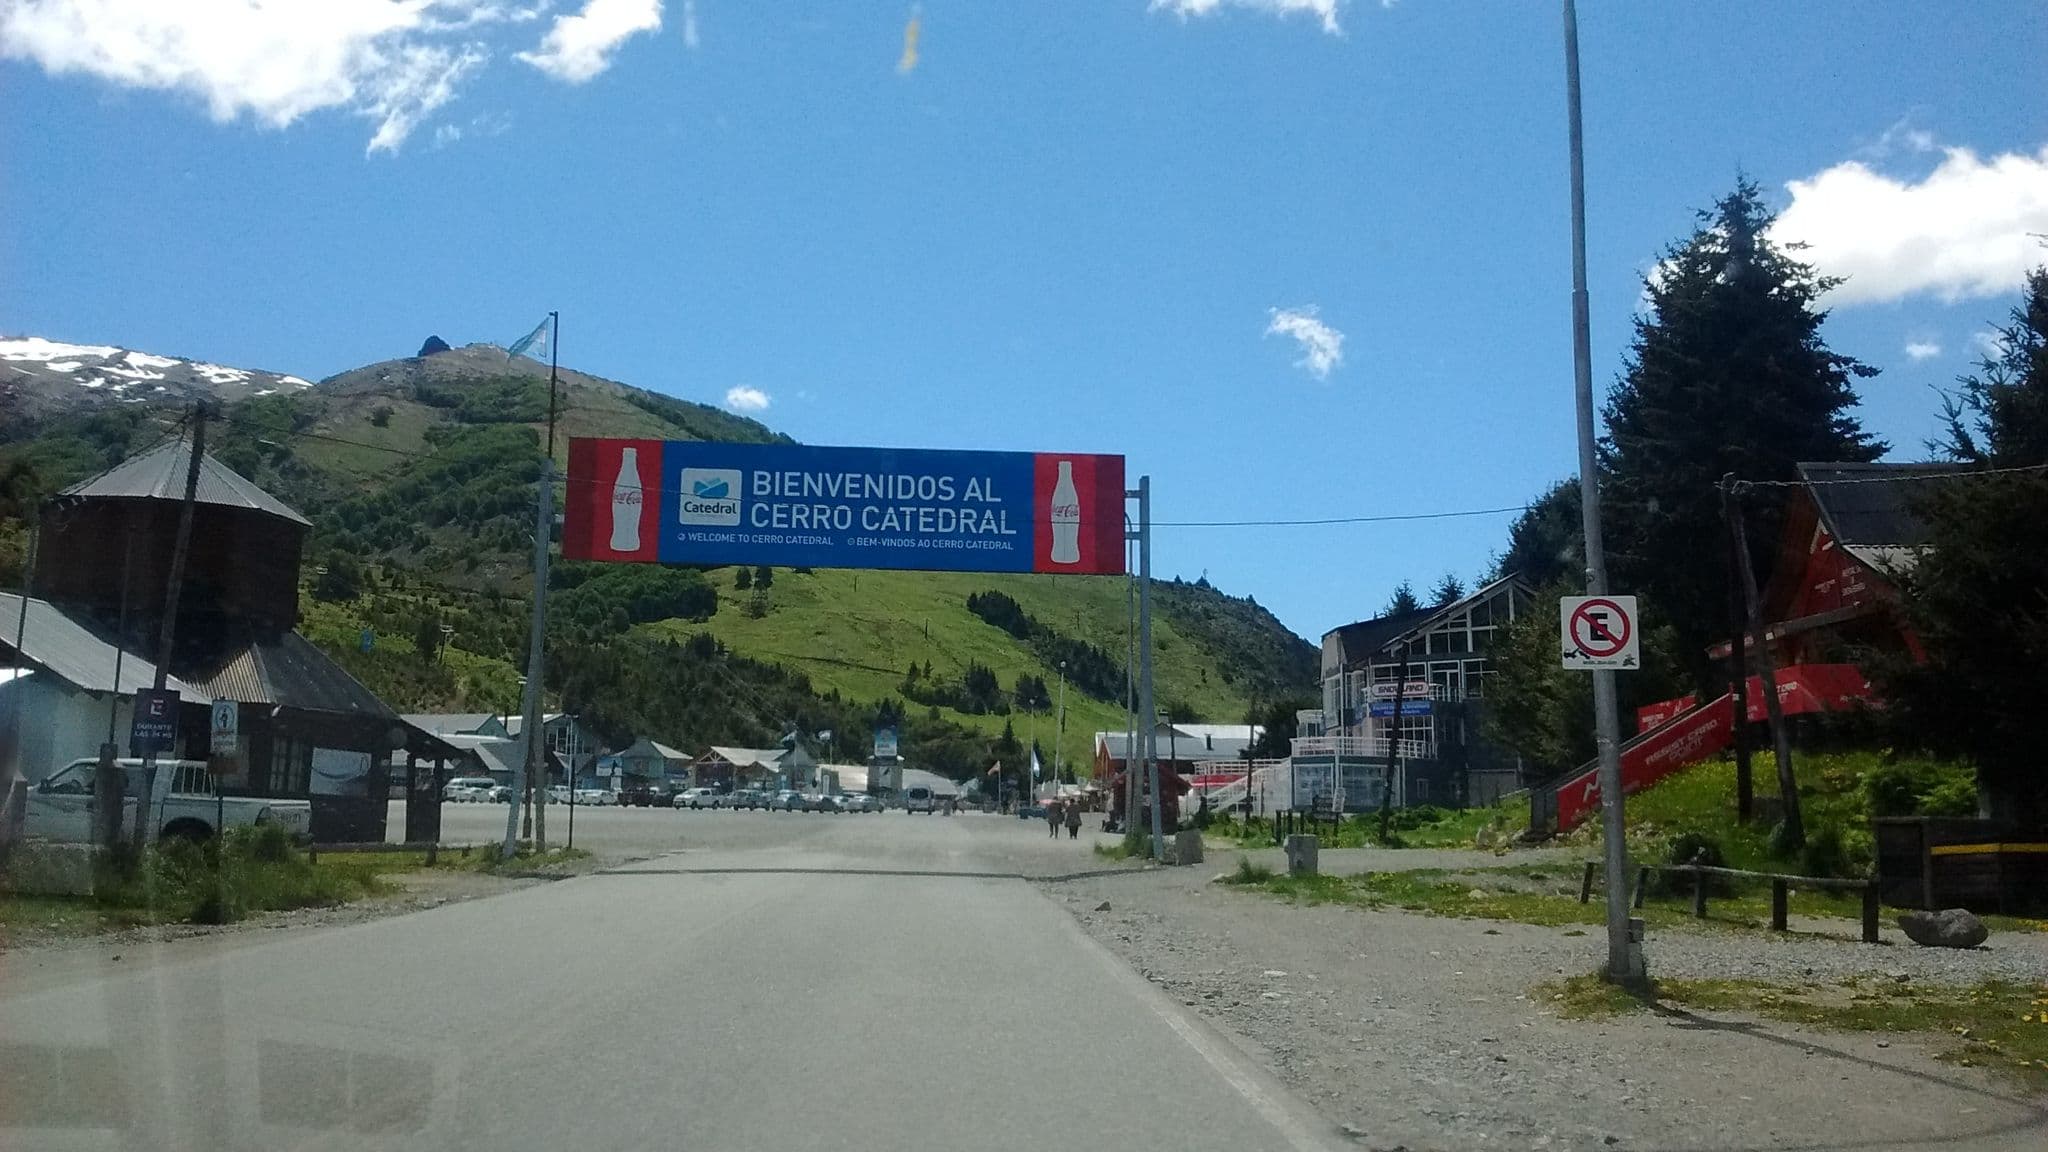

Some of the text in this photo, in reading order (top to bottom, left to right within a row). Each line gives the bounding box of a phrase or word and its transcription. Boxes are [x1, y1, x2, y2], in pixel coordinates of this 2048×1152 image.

[752, 470, 1001, 503] BIENVENIDOS AL
[684, 501, 737, 514] Catedral
[751, 502, 1017, 535] CERRO CATEDRAL
[688, 533, 833, 545] WELCOME TO CERRO CATEDRAL
[856, 538, 1014, 551] BEM-VINDOS AO CERRO CATEDRAL
[1589, 613, 1609, 641] E
